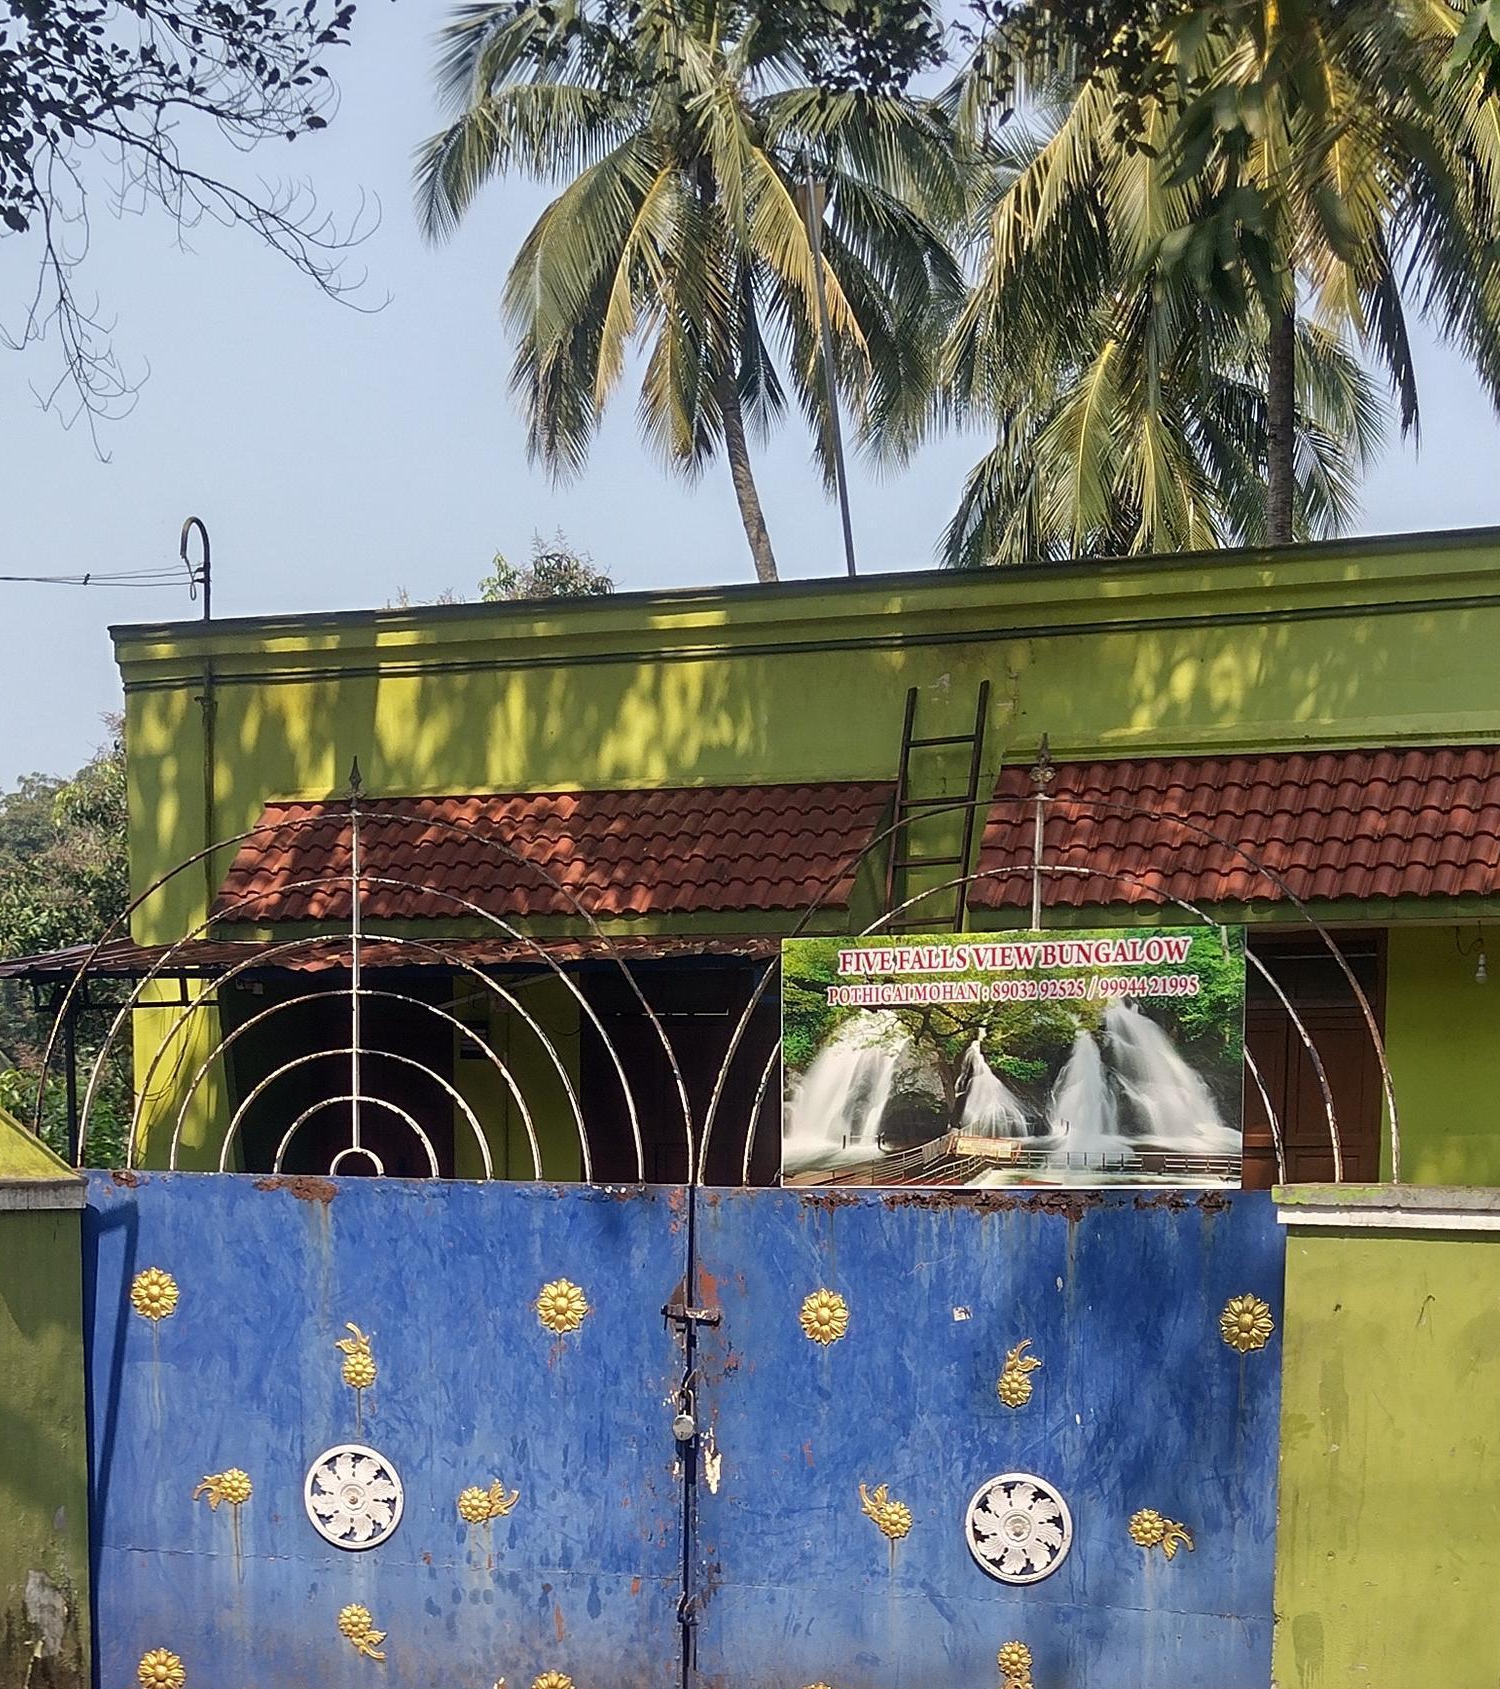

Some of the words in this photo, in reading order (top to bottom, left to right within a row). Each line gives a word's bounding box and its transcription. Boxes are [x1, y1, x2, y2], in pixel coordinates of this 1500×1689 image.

[840, 950, 893, 972] FIVE
[899, 948, 967, 970] FALLS
[973, 945, 1038, 968] VIEW
[1041, 939, 1190, 965] BUNGALOW
[914, 984, 979, 1001] MOHAN
[992, 982, 1036, 999] 89032
[1040, 980, 1085, 997] 92525
[1100, 978, 1147, 996] 99944
[1150, 977, 1198, 994] 21995
